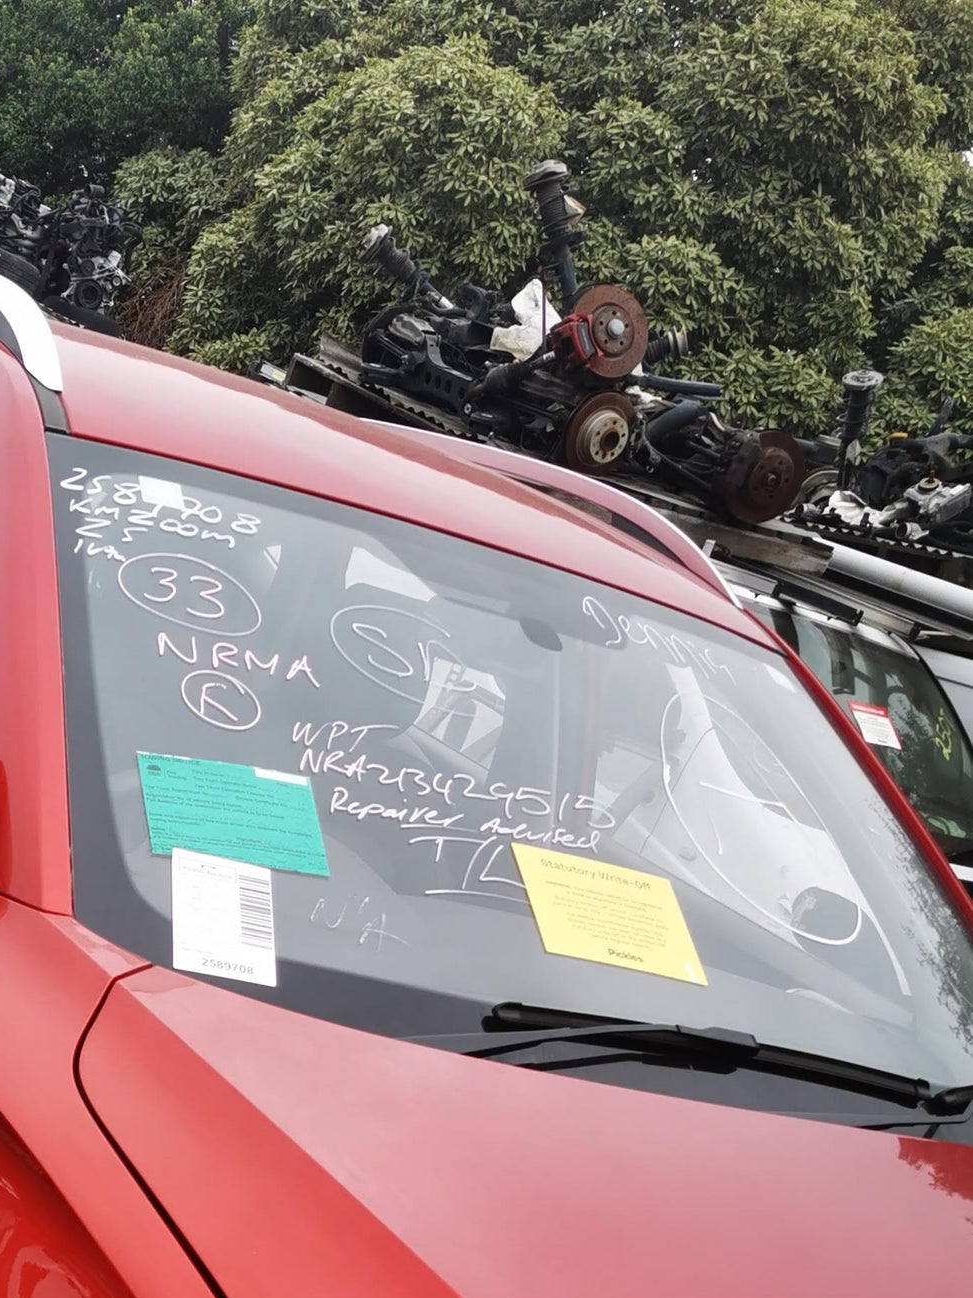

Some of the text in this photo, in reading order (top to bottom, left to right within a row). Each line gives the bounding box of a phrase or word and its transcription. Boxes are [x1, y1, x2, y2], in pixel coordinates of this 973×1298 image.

[143, 567, 225, 619] 33
[157, 632, 320, 689] NRMA
[292, 720, 401, 752] WPT
[540, 858, 596, 880] Statutory
[201, 957, 255, 976] 2589708
